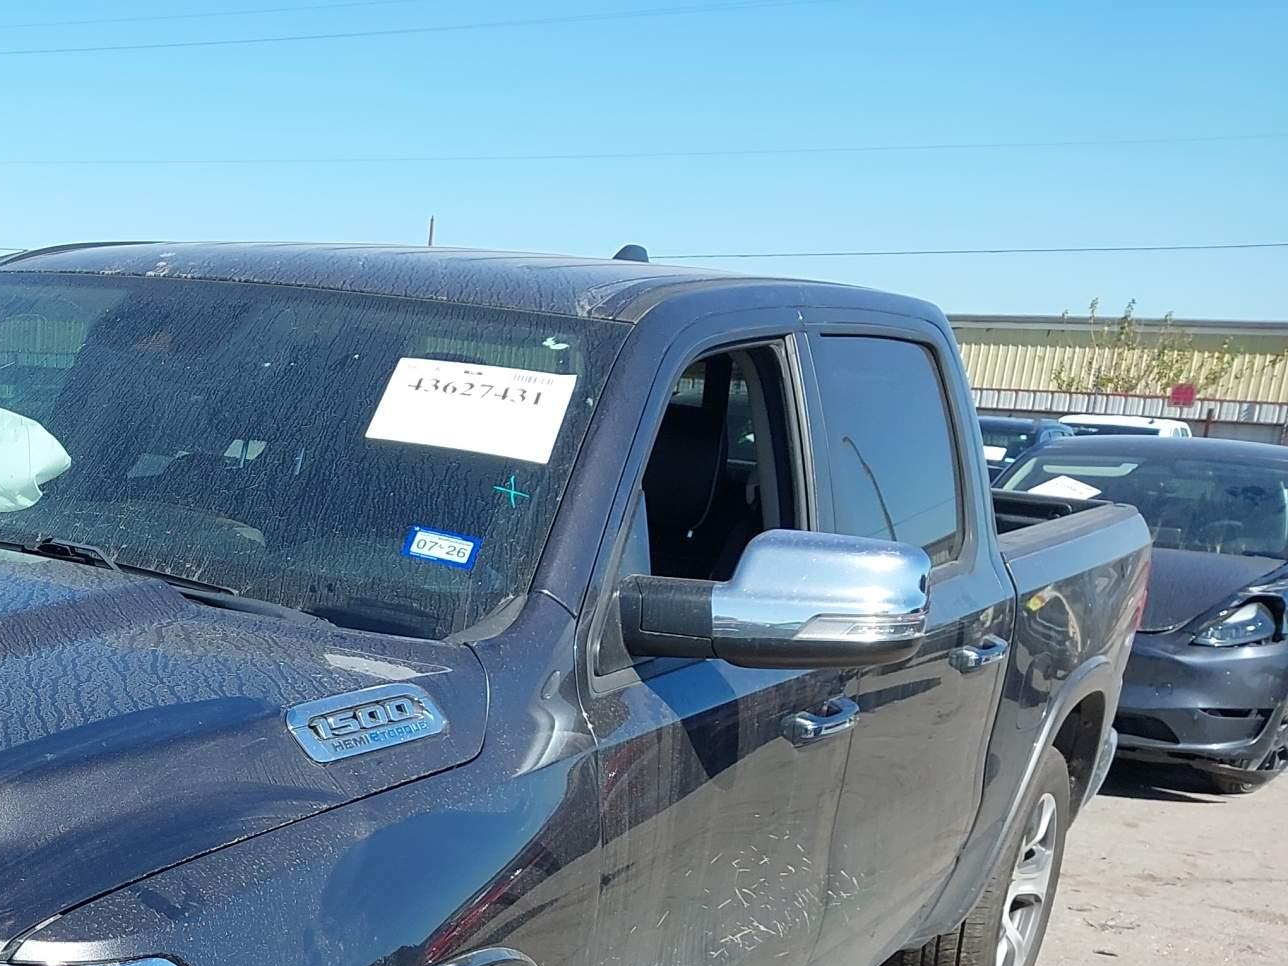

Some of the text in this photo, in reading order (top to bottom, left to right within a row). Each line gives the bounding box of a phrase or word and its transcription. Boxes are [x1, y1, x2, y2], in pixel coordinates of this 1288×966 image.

[408, 377, 542, 405] 43627431
[311, 699, 414, 739] 1500
[332, 734, 370, 752] HEMI
